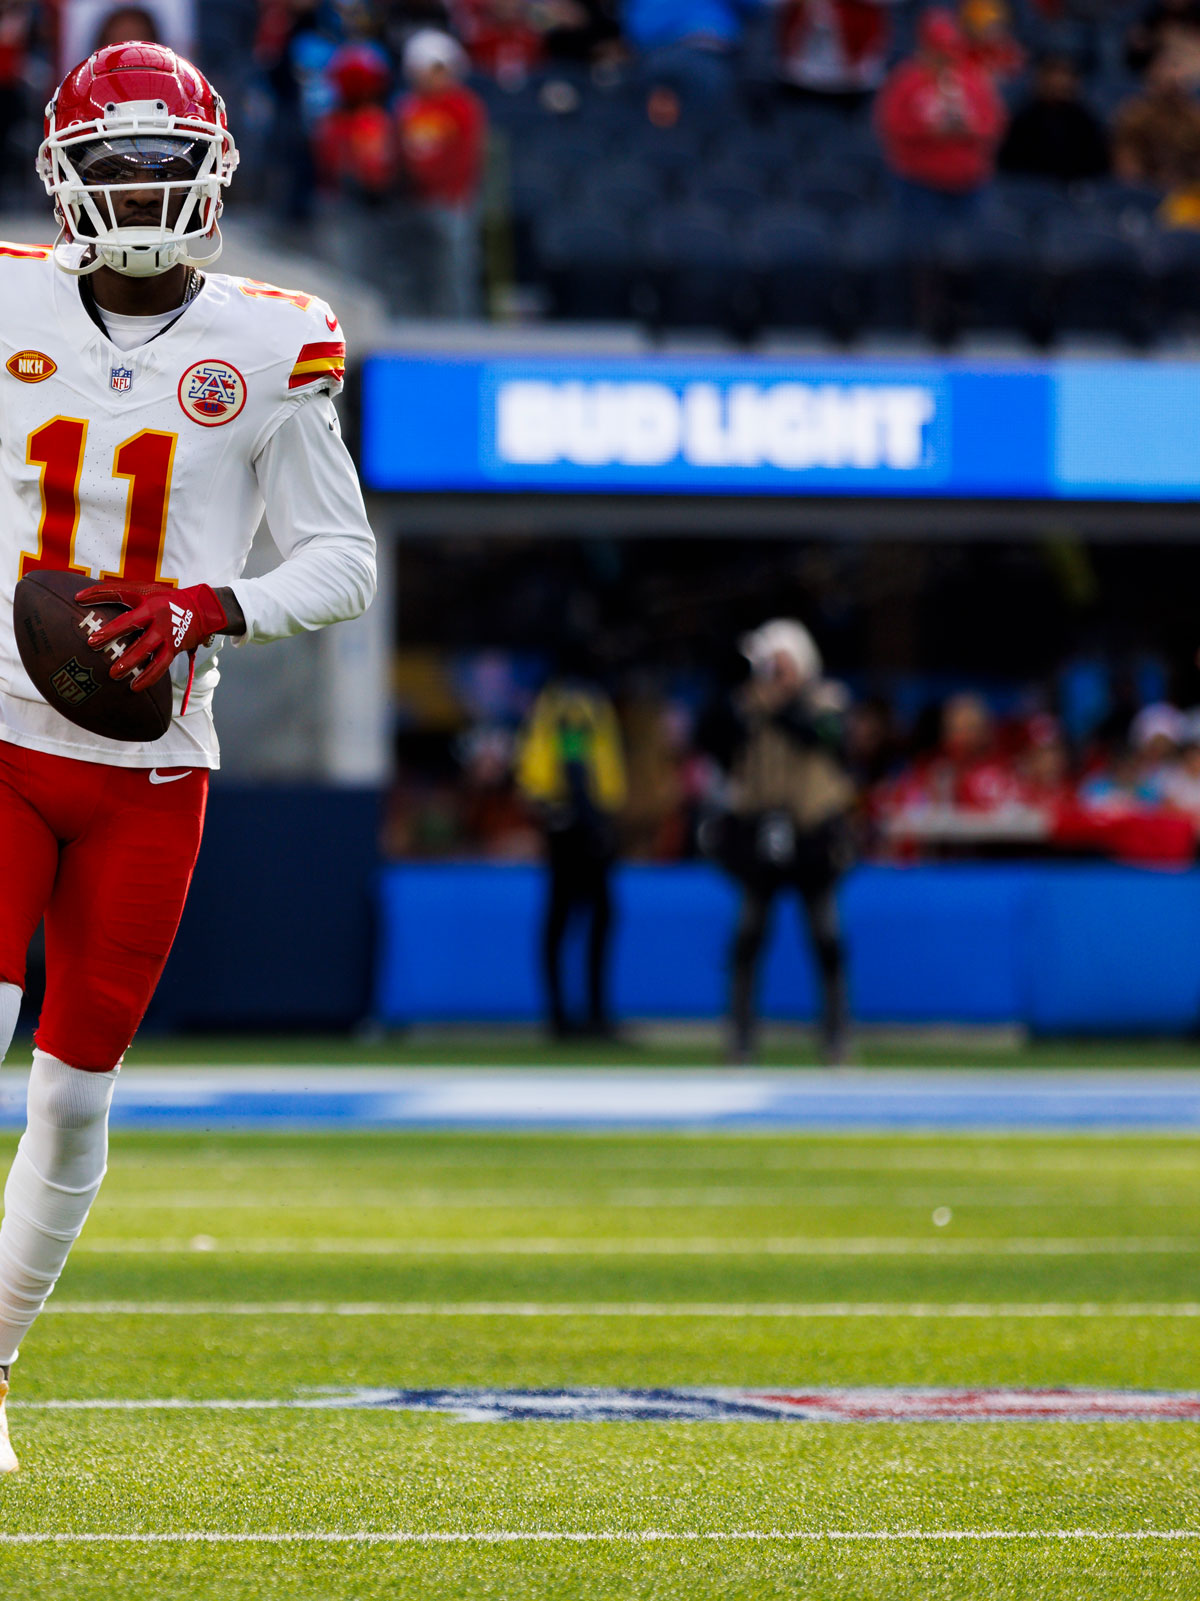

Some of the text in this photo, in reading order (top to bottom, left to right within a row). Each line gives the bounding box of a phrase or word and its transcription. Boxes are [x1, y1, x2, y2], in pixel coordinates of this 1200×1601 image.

[18, 358, 44, 375] NKH
[112, 376, 130, 390] NFL
[500, 380, 936, 471] BUD LIGHT
[18, 415, 179, 589] 11
[174, 609, 194, 648] adidas
[52, 670, 84, 701] NFL
